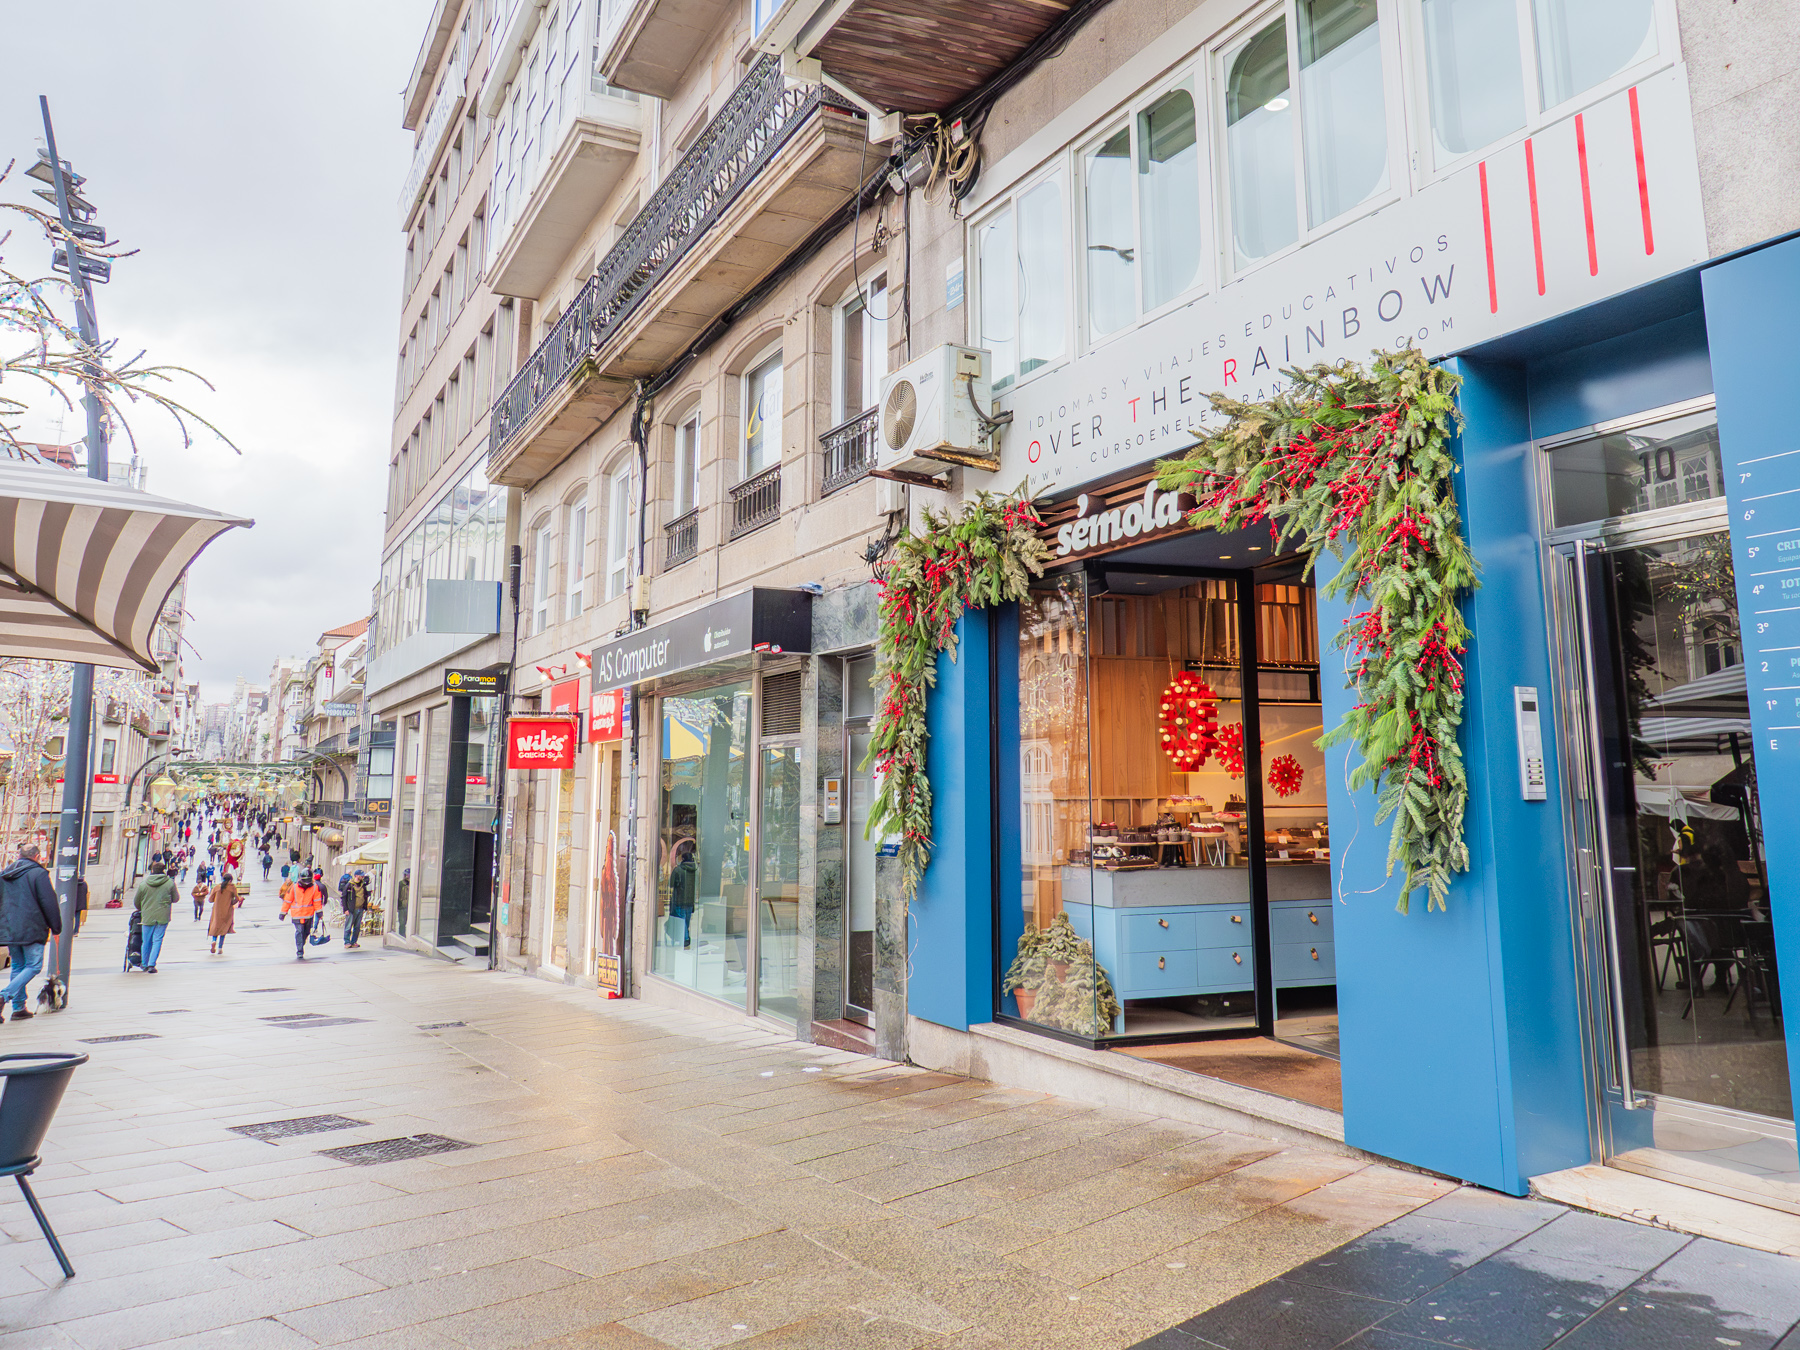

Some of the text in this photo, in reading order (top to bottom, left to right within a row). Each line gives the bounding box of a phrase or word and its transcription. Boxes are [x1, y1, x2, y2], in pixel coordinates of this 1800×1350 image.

[1029, 234, 1448, 431] IDIOMAS Y VIAJES EDUCATIVOS
[1028, 263, 1455, 464] OVER THE RAINBOW
[1638, 446, 1677, 484] 10
[598, 638, 671, 684] AS Computer
[1761, 661, 1769, 672] 2
[463, 674, 497, 683] Faramon
[516, 729, 566, 752] Nikis
[1770, 739, 1778, 750] E
